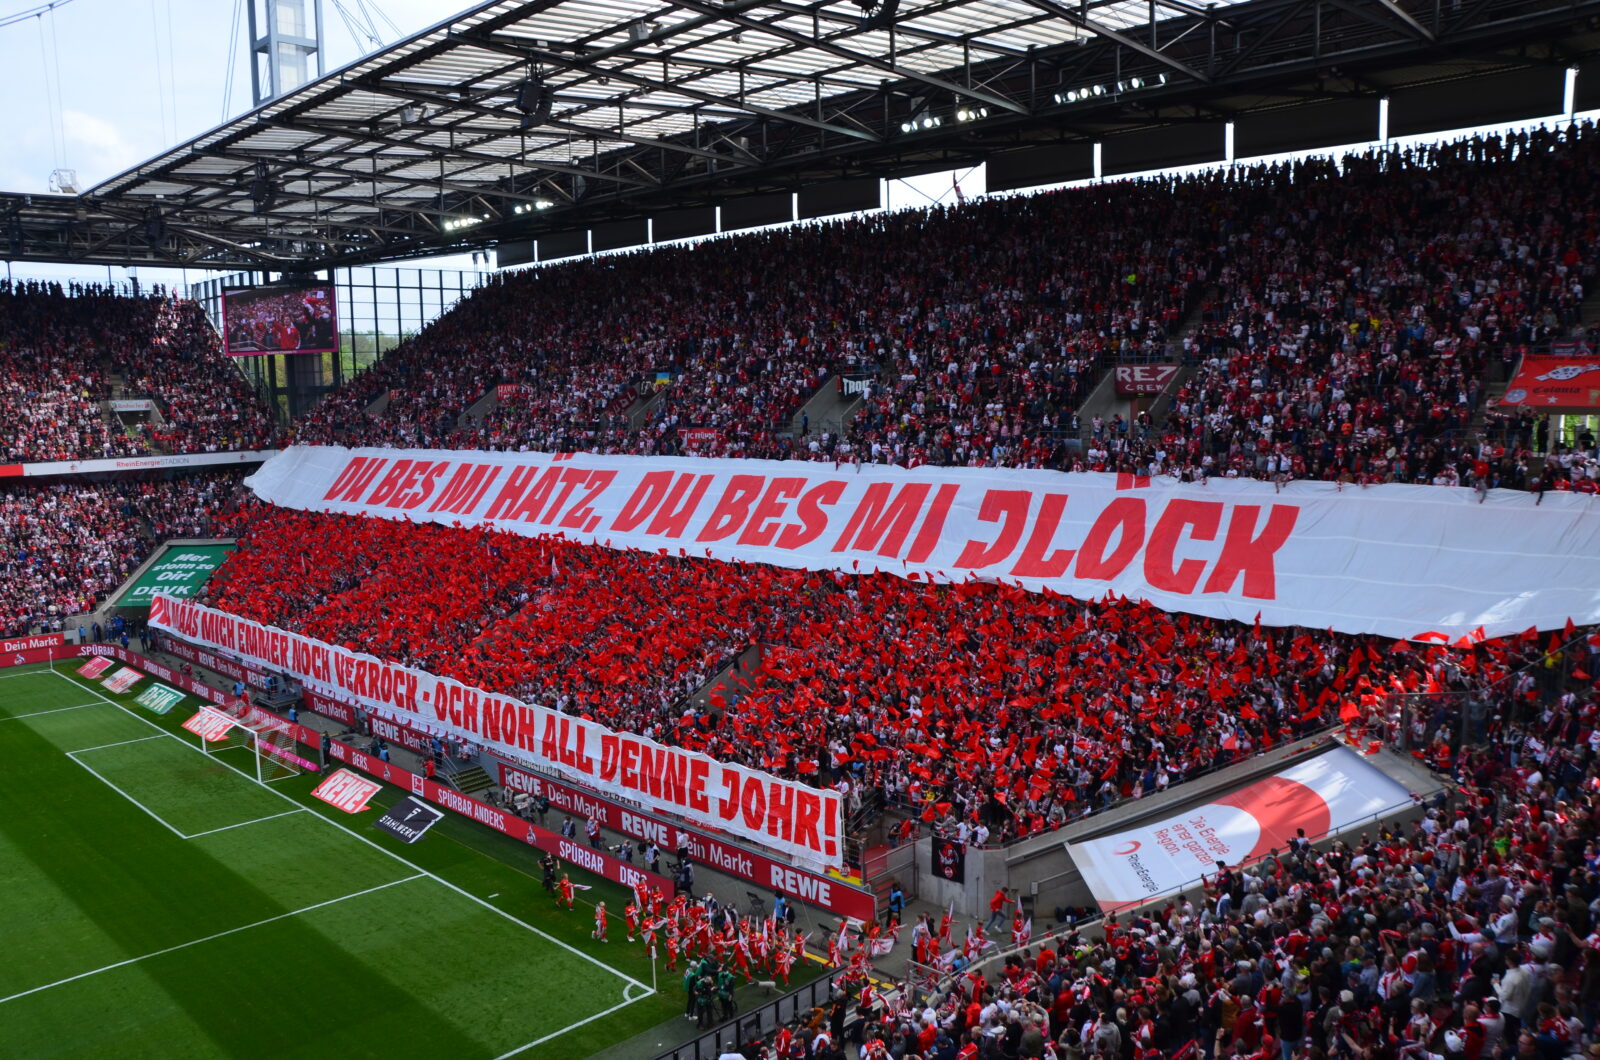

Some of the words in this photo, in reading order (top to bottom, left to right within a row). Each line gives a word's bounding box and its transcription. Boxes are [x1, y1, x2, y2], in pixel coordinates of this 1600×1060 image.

[1116, 366, 1178, 382] RE7
[323, 457, 388, 501] DU
[365, 459, 450, 510] BES
[426, 463, 503, 514] MI
[484, 452, 619, 533] HÄTZ,
[609, 470, 715, 539] DU
[695, 474, 848, 550] BES
[830, 482, 960, 563] MI
[952, 472, 1301, 600] JLÖCK
[172, 553, 211, 562] Mer
[132, 586, 193, 596] DEVK
[156, 571, 196, 581] Dir!
[4, 640, 24, 652] Dein
[29, 637, 58, 648] Markt
[81, 644, 115, 658] SPÜRBAR
[140, 686, 177, 712] DEVK
[313, 698, 328, 715] Dein
[328, 702, 348, 721] Markt
[201, 611, 235, 650] MICH
[238, 622, 289, 669] EMMER
[292, 638, 331, 683] NOCH
[335, 659, 419, 713] VERRÖCK
[434, 681, 478, 734] OCH
[482, 697, 535, 752] NOH
[541, 713, 594, 775] ALL
[600, 734, 710, 813] DENNE
[719, 768, 838, 857] JOHR!
[372, 717, 400, 742] REWE
[402, 730, 421, 750] Dein
[315, 768, 372, 810] REWE
[504, 767, 542, 796] REWE
[548, 783, 571, 809] Dein
[573, 793, 608, 823] Markt
[438, 788, 473, 819] SPÜRBAR
[473, 803, 507, 832] ANDERS.
[378, 815, 418, 839] STAHLWERK
[1154, 828, 1181, 857] Region.
[1189, 815, 1206, 830] Die
[1198, 827, 1230, 855] Energie
[559, 840, 604, 874] SPÜRBAR
[621, 811, 669, 847] REWE
[709, 842, 753, 878] Markt
[1171, 823, 1193, 841] einer
[1182, 839, 1216, 867] ganzen
[770, 864, 832, 907] REWE
[1128, 853, 1159, 893] RheinEnergie
